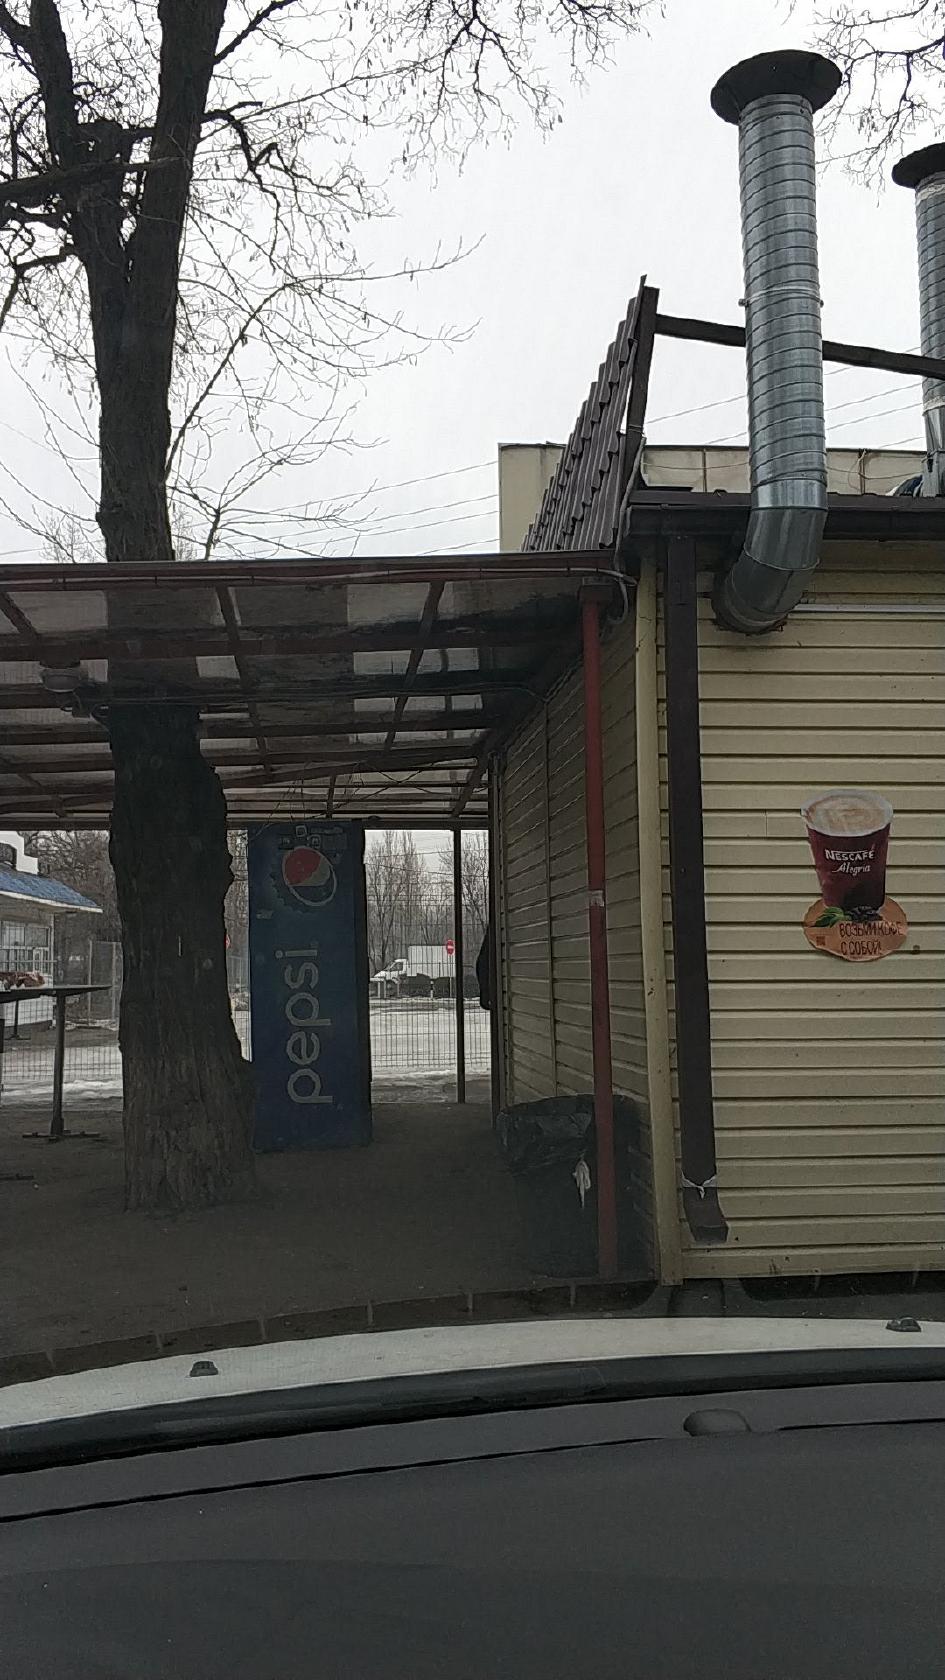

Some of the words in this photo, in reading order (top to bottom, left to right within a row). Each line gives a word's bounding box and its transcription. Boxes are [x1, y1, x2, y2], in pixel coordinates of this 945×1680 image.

[832, 862, 871, 877] Alegria
[839, 922, 877, 938] ВОЗЬМИ
[841, 941, 848, 956] С
[275, 948, 333, 1104] pepsi
